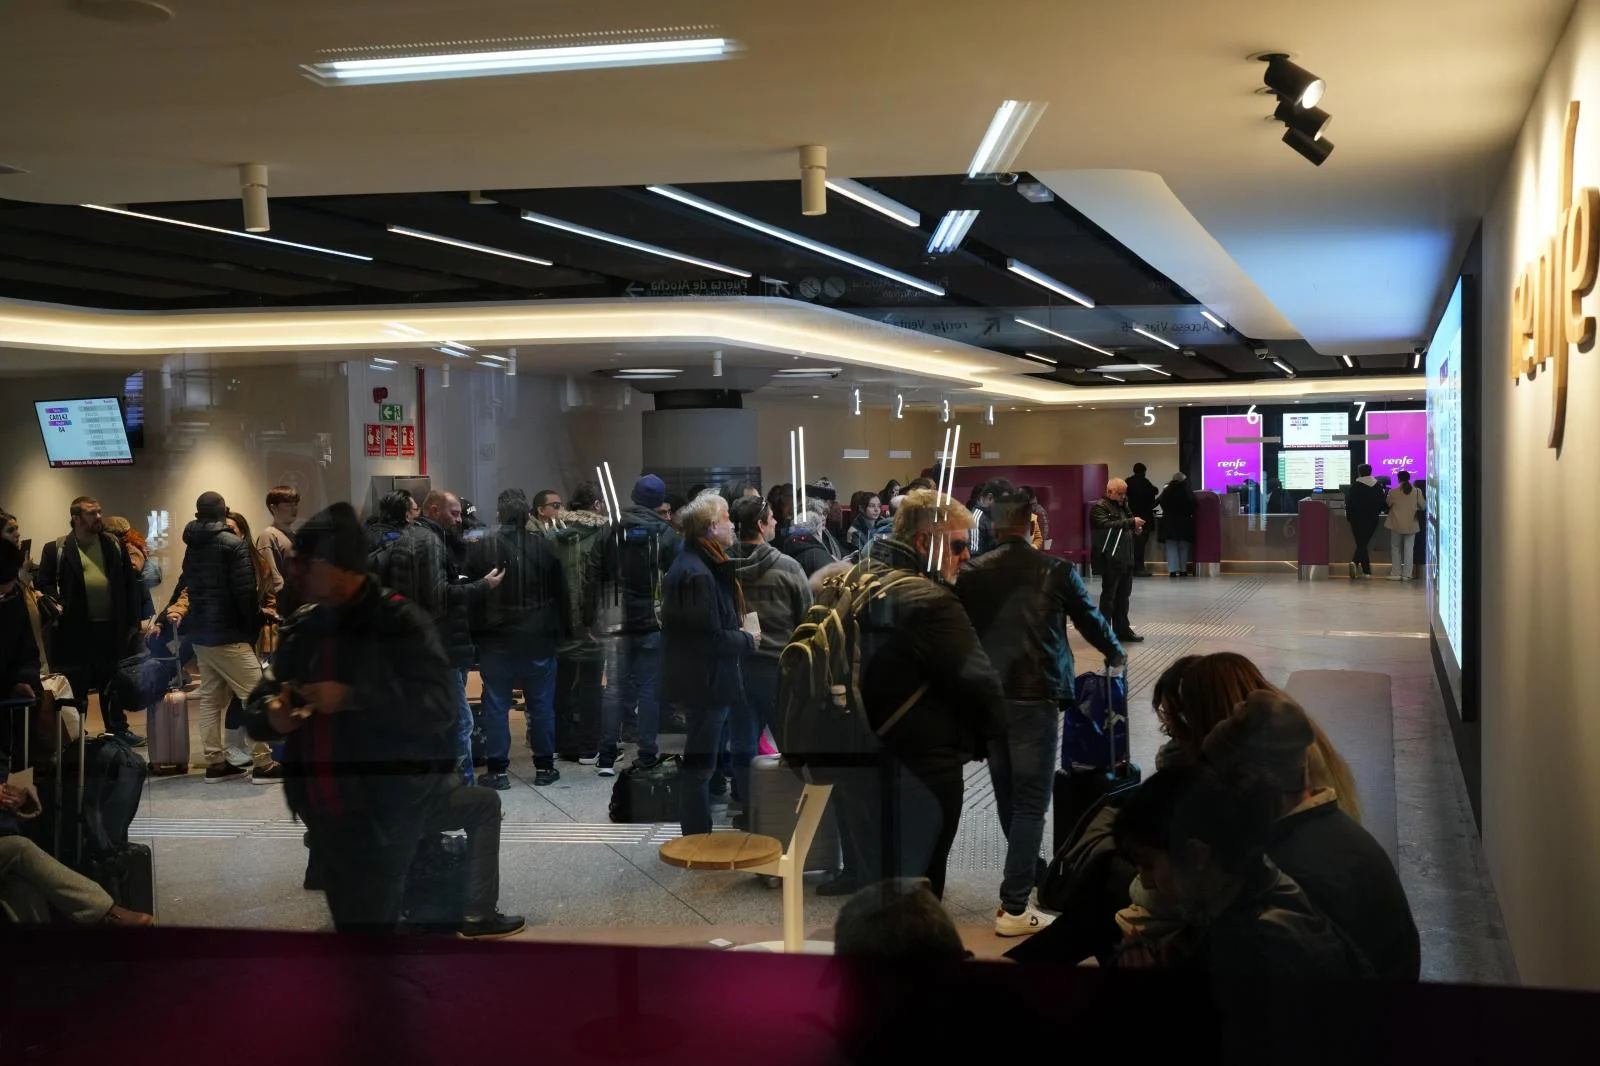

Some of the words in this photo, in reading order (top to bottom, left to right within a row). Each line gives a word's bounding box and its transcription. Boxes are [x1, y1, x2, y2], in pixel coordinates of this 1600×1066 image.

[854, 388, 861, 416] 1
[897, 394, 903, 419] 2
[943, 399, 950, 422] 3
[1353, 402, 1366, 422] 7
[1144, 406, 1155, 426] 5
[1246, 404, 1259, 425] 6
[1217, 458, 1247, 470] renfe
[1382, 456, 1414, 468] renfe
